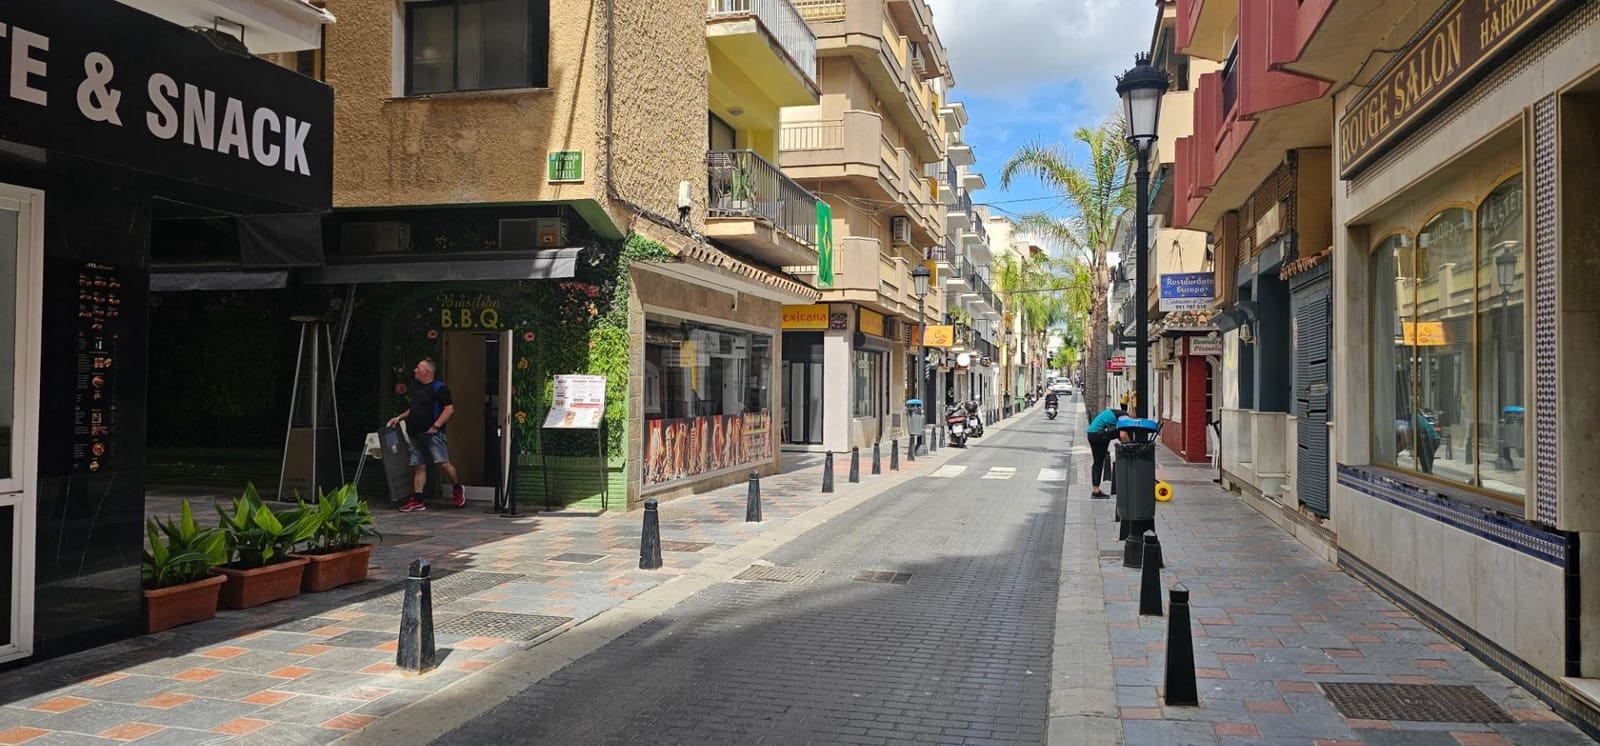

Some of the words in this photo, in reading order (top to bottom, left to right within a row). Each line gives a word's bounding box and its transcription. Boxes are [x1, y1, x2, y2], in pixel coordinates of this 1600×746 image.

[0, 21, 50, 107] E
[76, 51, 123, 127] &
[146, 72, 312, 177] SNACK
[1341, 87, 1390, 163] ROUGE
[1393, 12, 1463, 118] SALON
[441, 308, 504, 329] B.B.Q.
